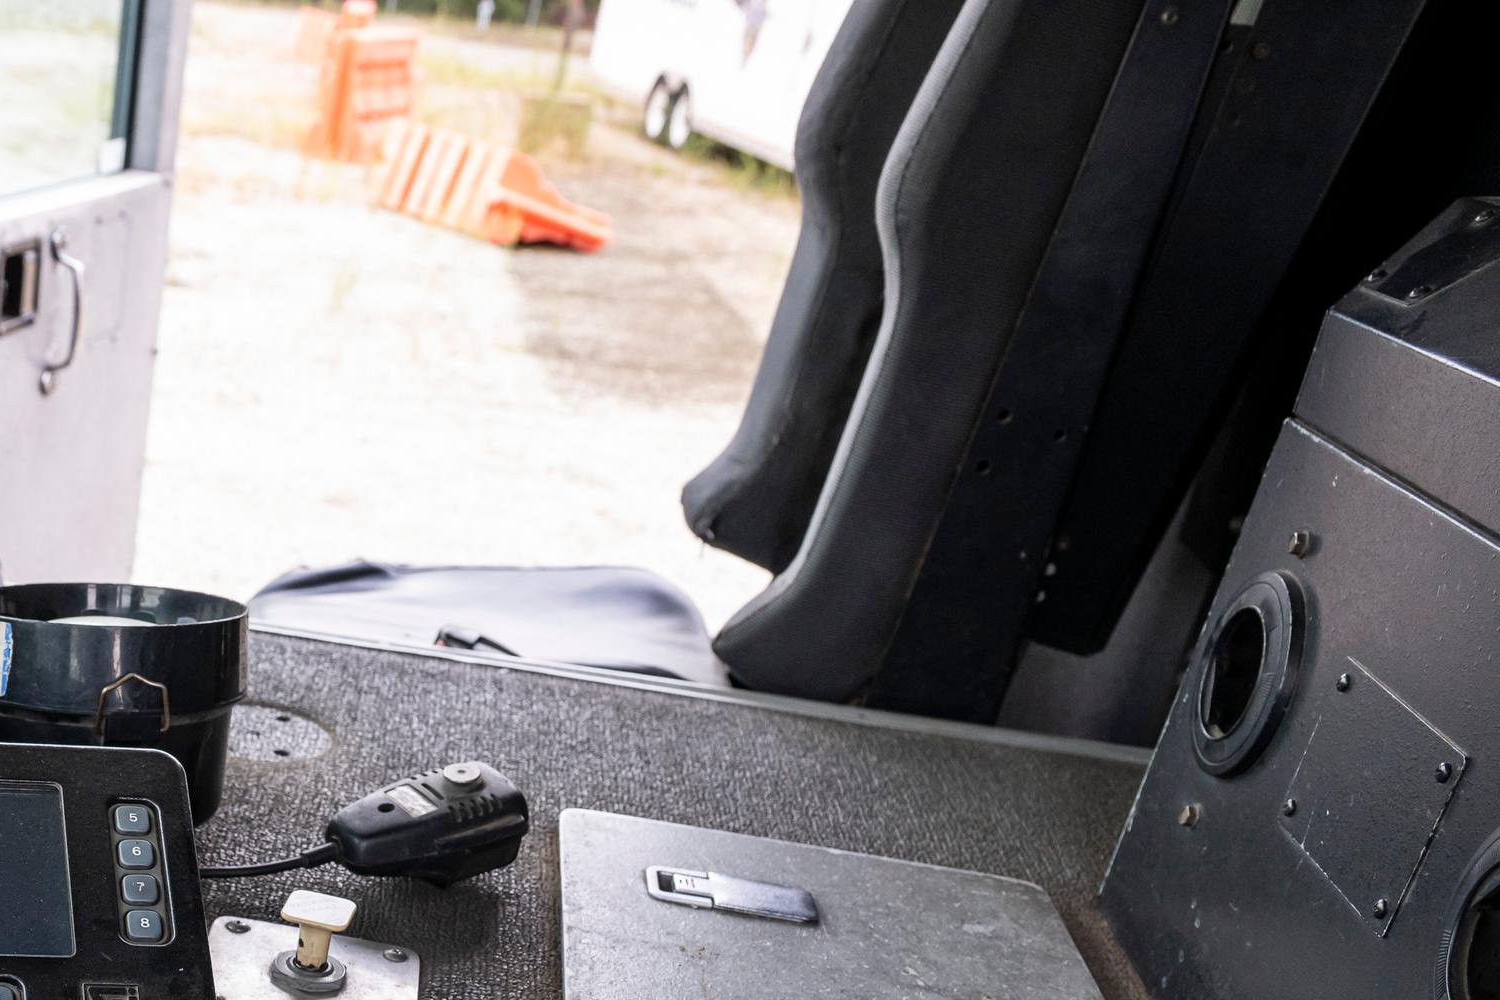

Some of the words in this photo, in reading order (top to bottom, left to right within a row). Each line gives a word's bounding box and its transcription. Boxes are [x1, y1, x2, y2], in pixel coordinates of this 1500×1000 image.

[129, 812, 138, 822] 5
[132, 846, 142, 856] 6
[136, 882, 146, 892] 7
[140, 918, 150, 928] 8
